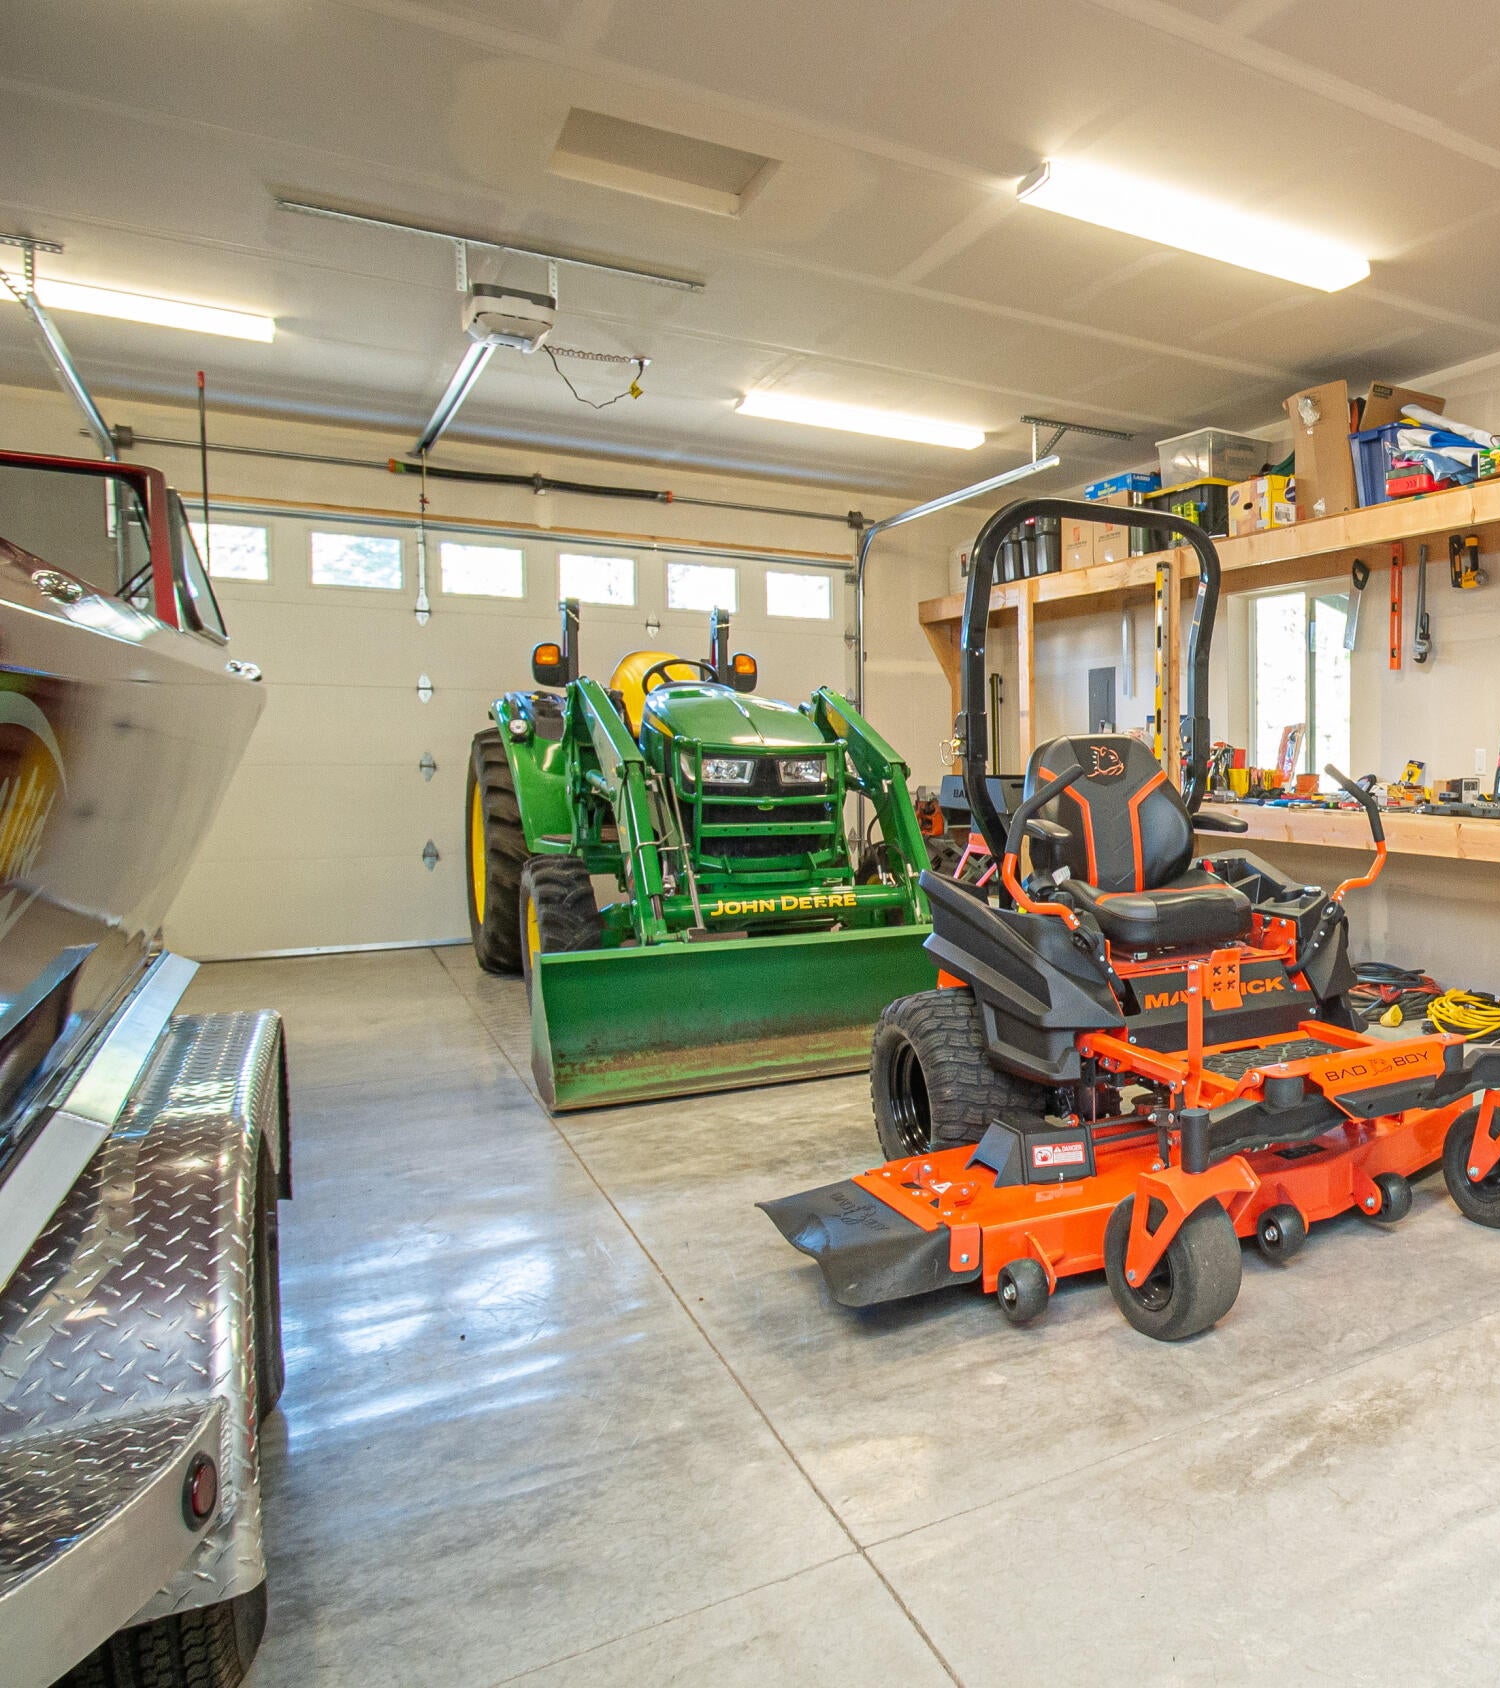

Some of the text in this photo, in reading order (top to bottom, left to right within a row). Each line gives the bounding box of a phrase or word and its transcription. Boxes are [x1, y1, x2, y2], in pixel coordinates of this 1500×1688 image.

[710, 893, 857, 917] JOHN DEERE
[1144, 976, 1285, 1009] MAICK
[1325, 1051, 1429, 1082] BAD BOY
